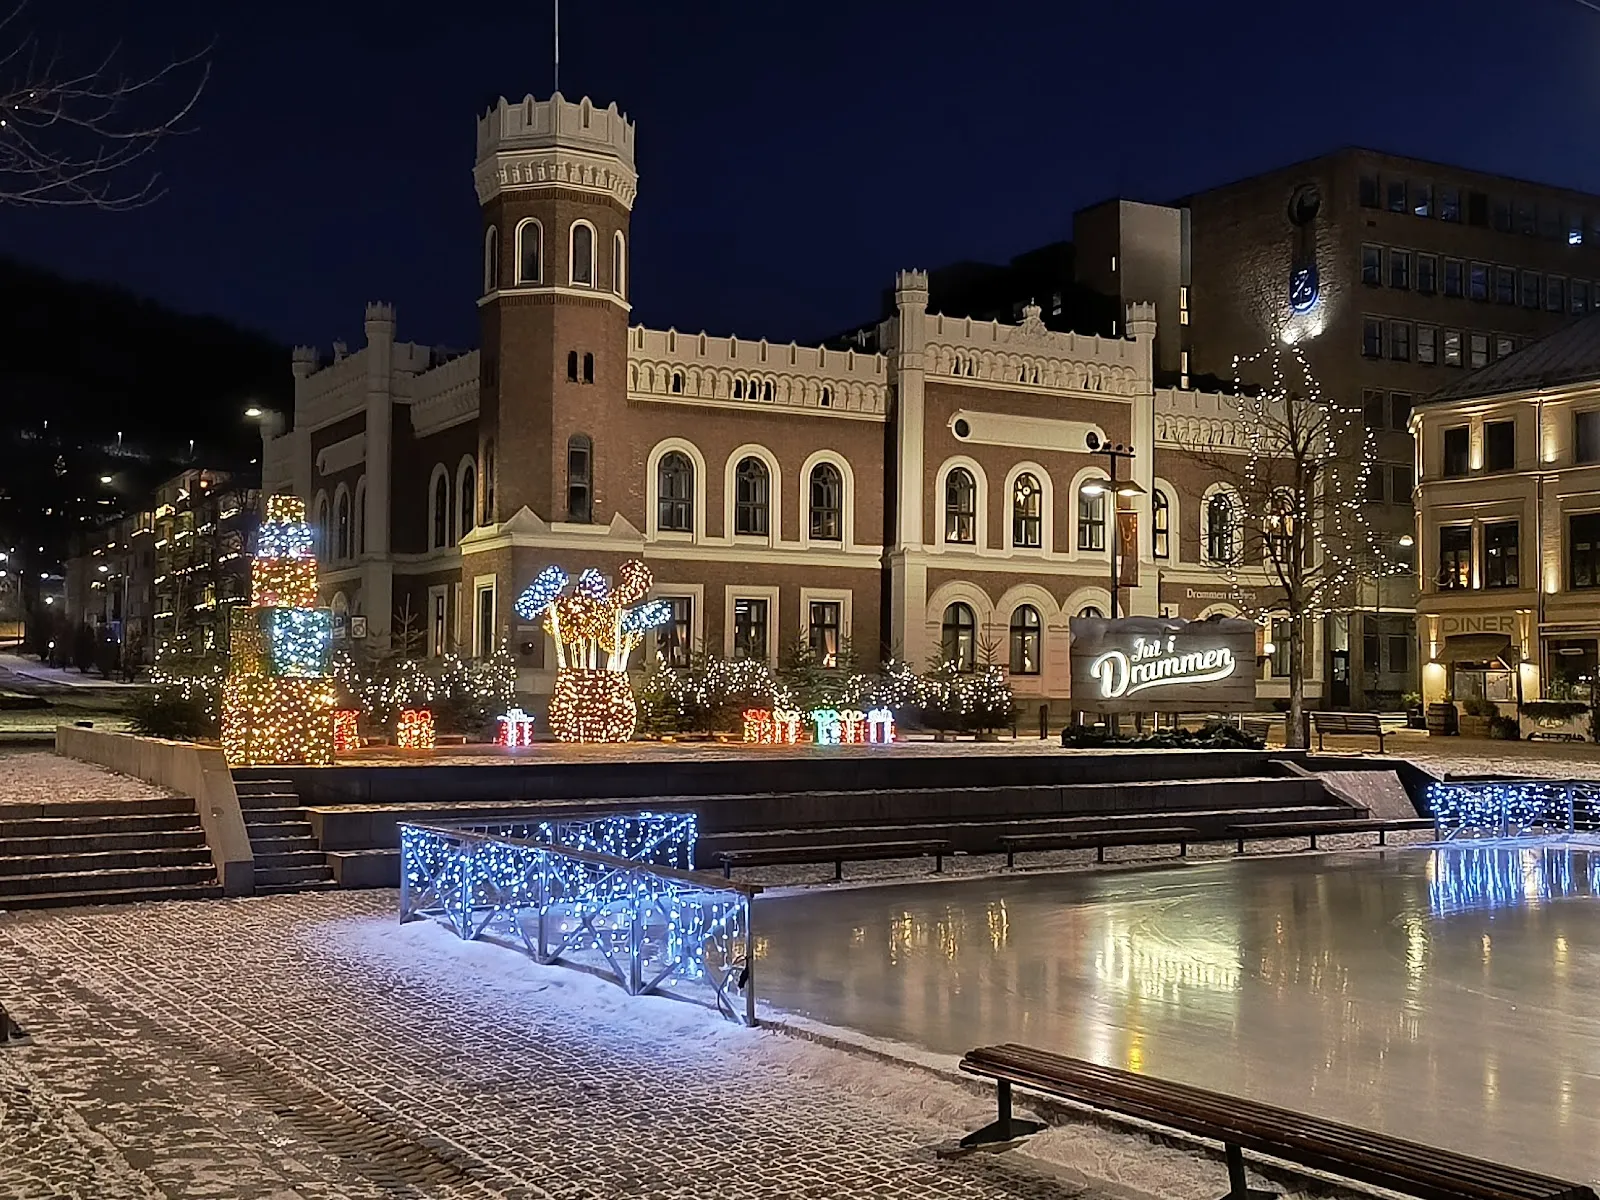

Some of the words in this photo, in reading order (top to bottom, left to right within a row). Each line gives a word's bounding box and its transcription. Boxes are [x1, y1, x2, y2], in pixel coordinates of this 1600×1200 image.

[1186, 588, 1227, 600] Drammen
[335, 617, 342, 627] P
[1442, 616, 1514, 632] DINER
[1131, 637, 1162, 662] Jul
[1167, 635, 1176, 653] i
[1090, 647, 1236, 698] Drammen
